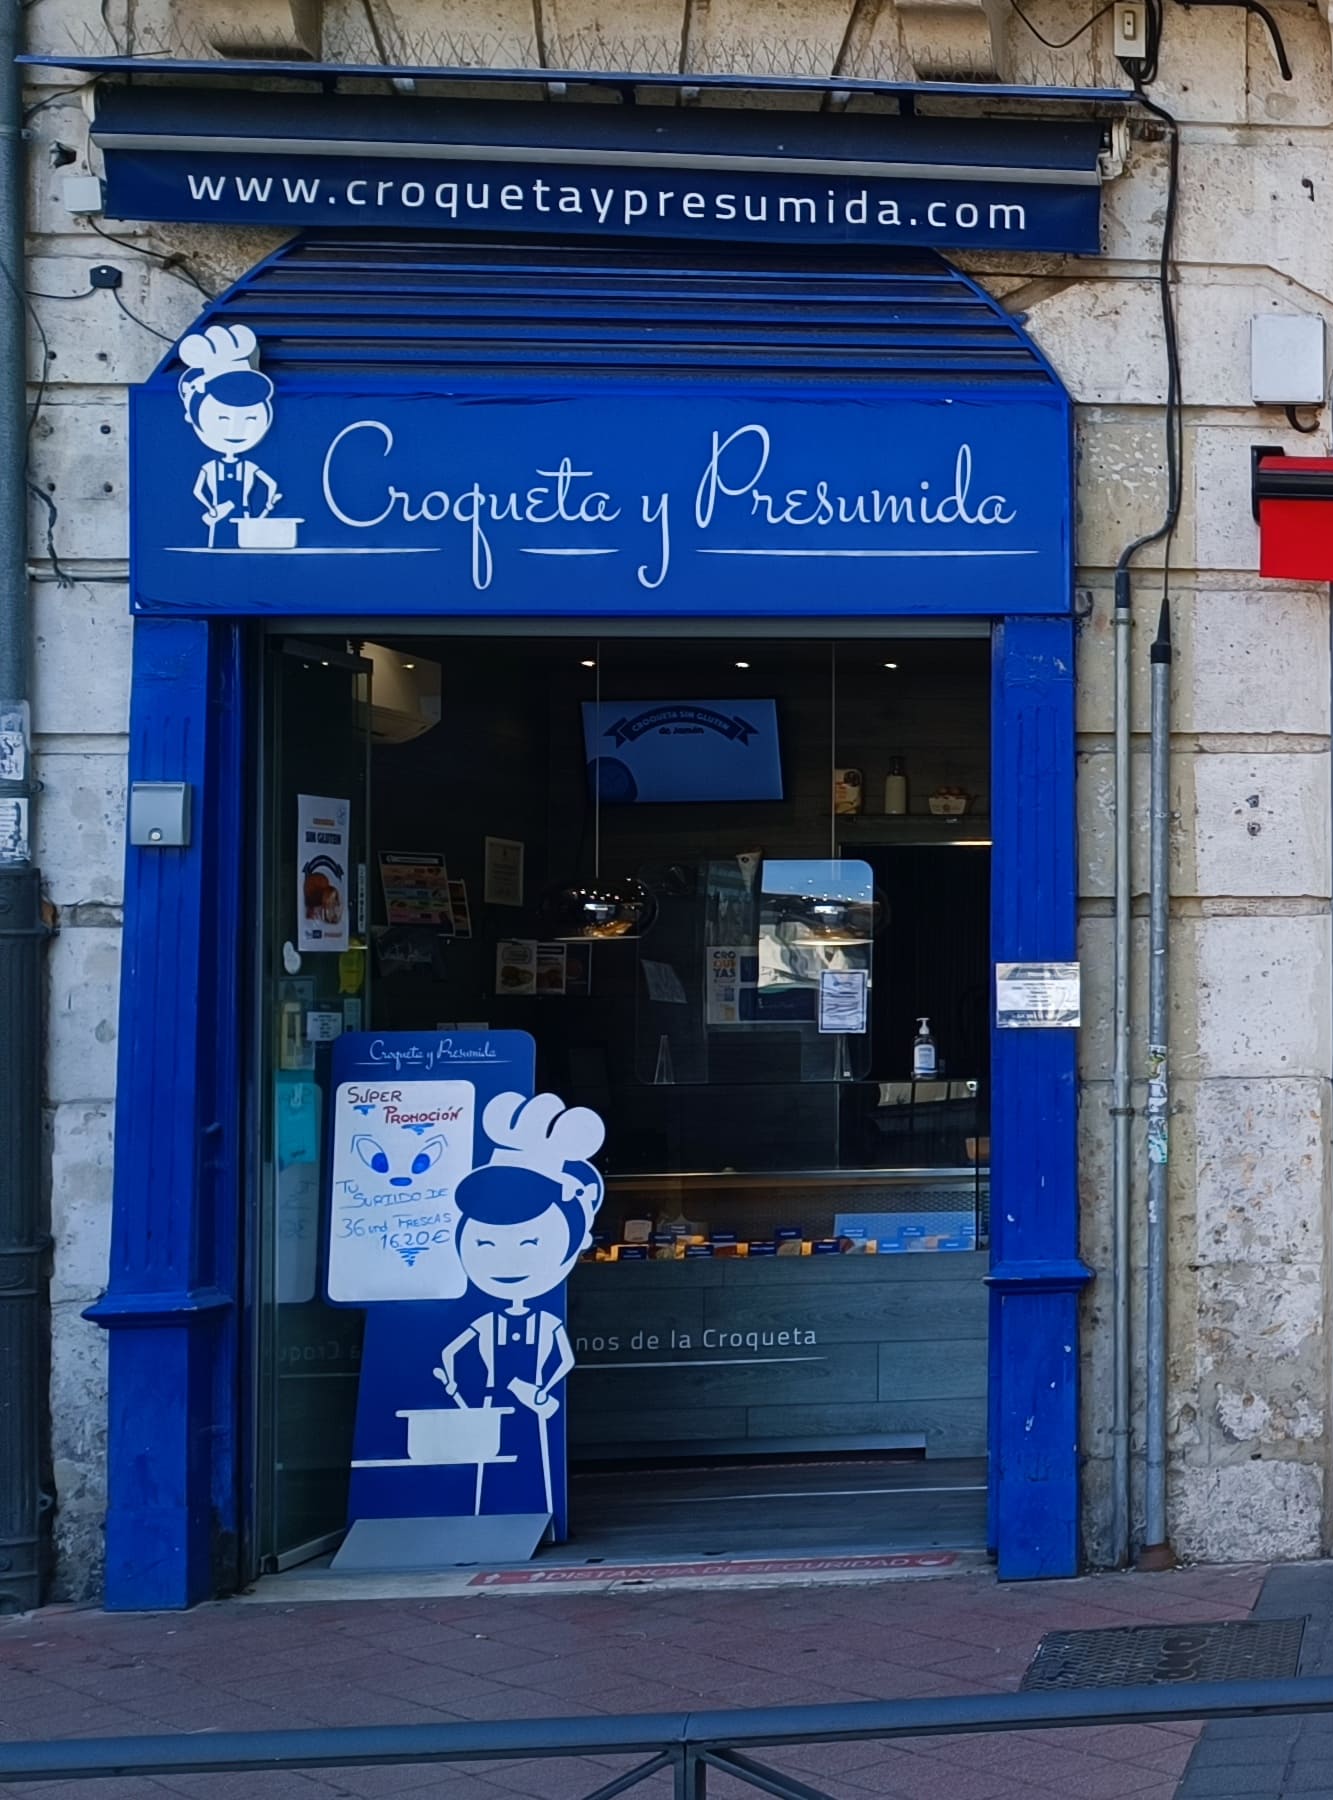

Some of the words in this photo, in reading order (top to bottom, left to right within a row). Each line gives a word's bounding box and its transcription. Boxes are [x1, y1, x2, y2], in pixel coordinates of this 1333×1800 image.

[187, 166, 1028, 231] www.croquetaypresumida.com
[321, 420, 622, 590] Croqueta
[639, 492, 670, 589] y
[694, 424, 1016, 530] Presumida
[369, 1040, 424, 1071] Croqueta
[426, 1049, 434, 1070] y
[436, 1038, 497, 1059] Presumida
[347, 1086, 403, 1104] SUPER
[336, 1217, 366, 1239] 36
[630, 1330, 660, 1351] de
[671, 1329, 692, 1350] la
[702, 1326, 818, 1352] Croqueta
[544, 1564, 697, 1582] DISTANCIA
[703, 1563, 737, 1576] DE
[743, 1556, 911, 1574] SEGURIDAD
